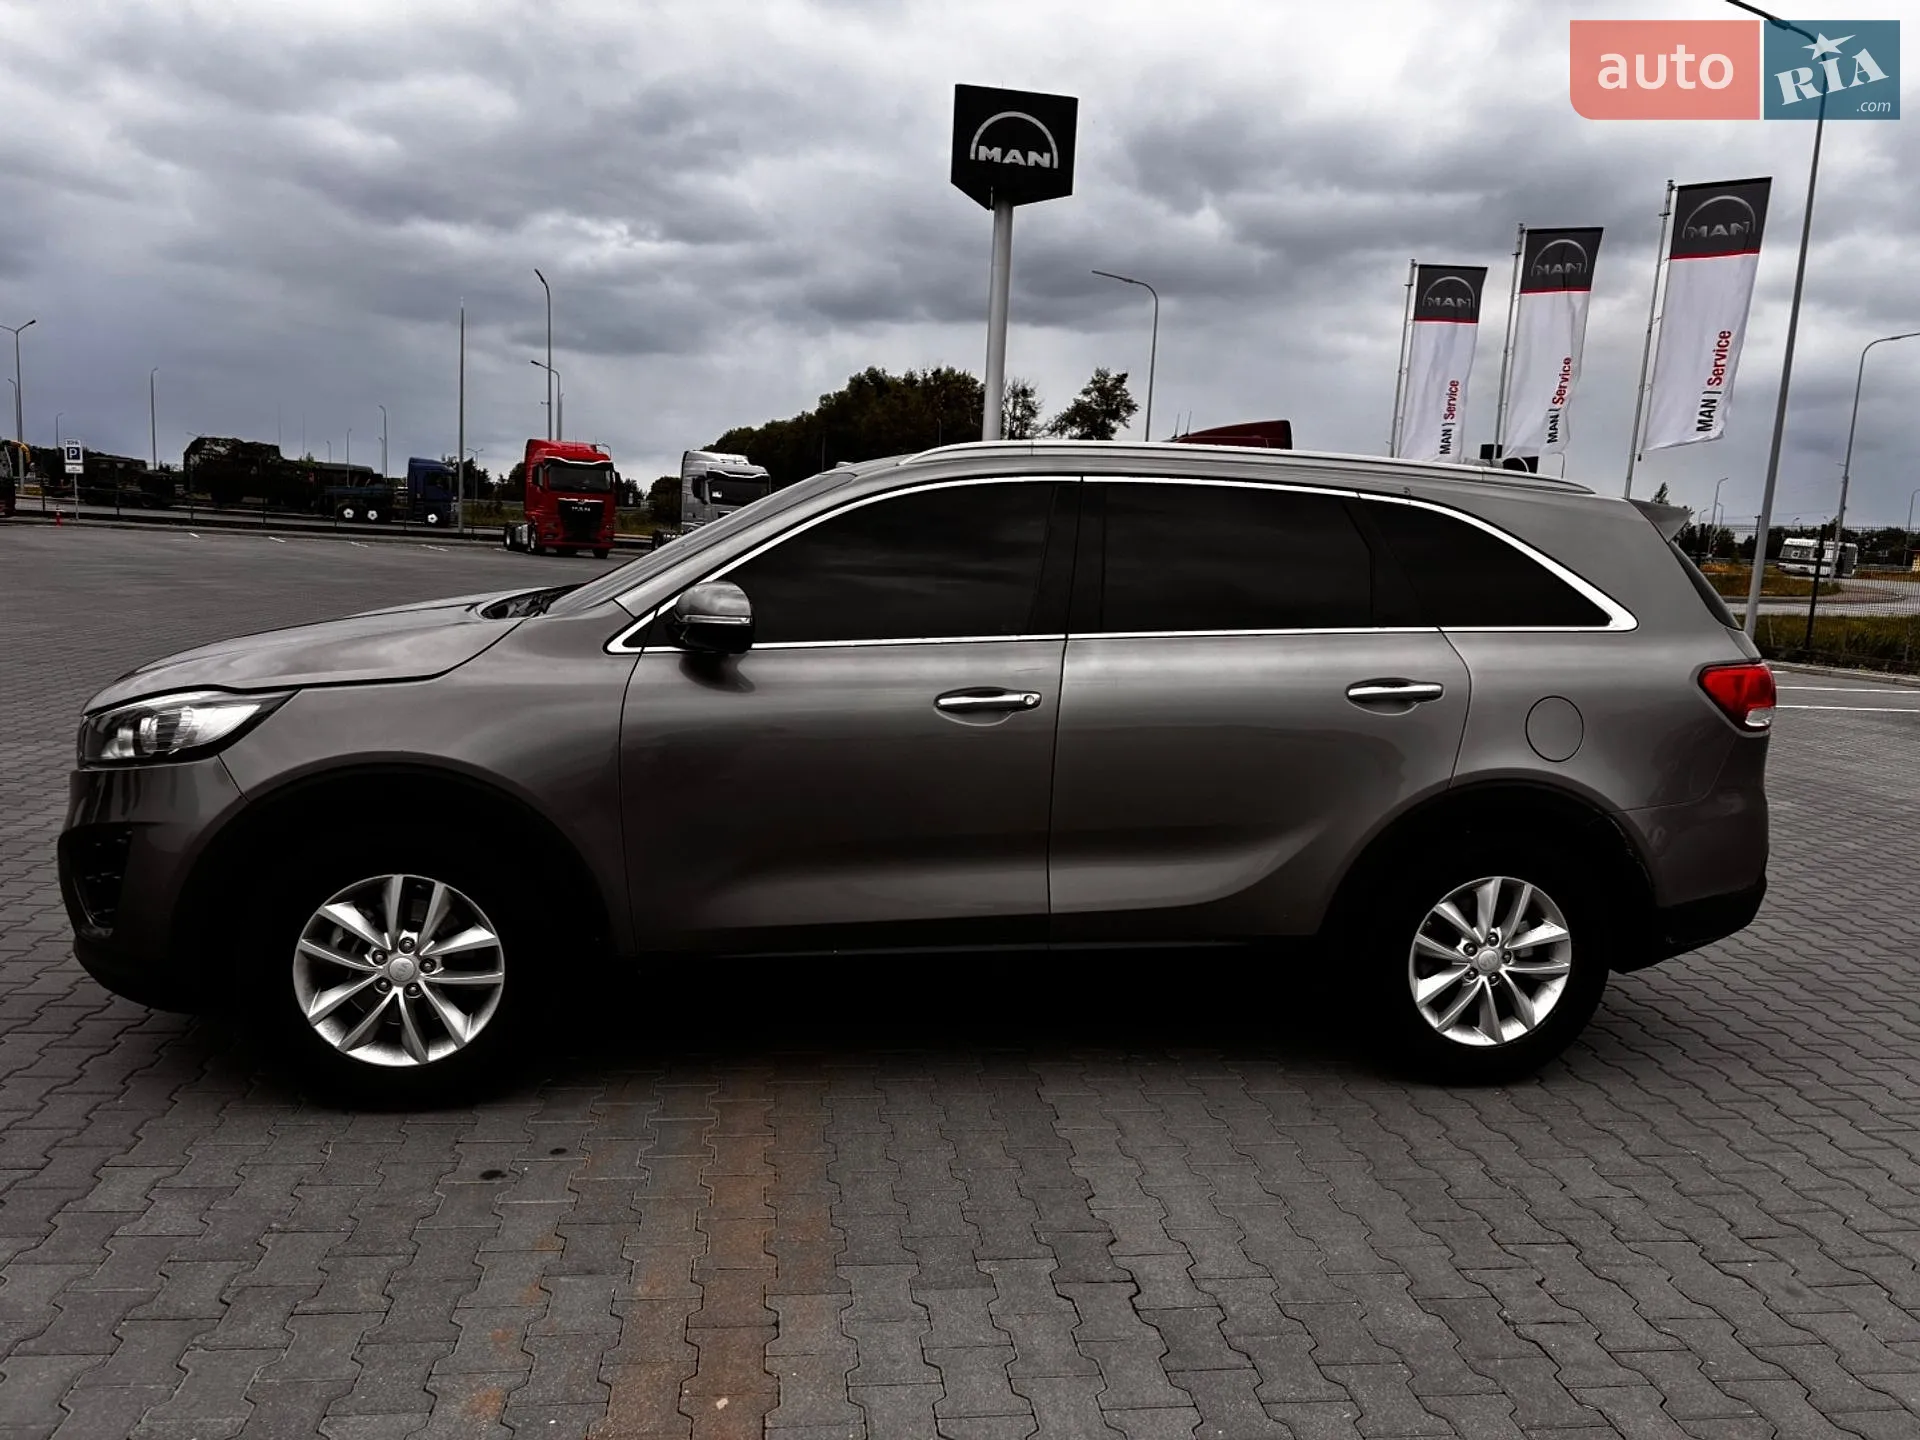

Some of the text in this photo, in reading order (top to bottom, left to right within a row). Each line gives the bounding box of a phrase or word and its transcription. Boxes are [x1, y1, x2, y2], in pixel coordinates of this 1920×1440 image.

[978, 145, 1051, 168] MAN
[1687, 221, 1750, 238] MAN
[1535, 263, 1582, 276] MAN
[1427, 297, 1472, 308] MAN
[1696, 330, 1732, 432] MAN Service
[1546, 357, 1572, 444] MAN Service
[1439, 380, 1460, 455] MAN Service
[69, 448, 78, 459] P
